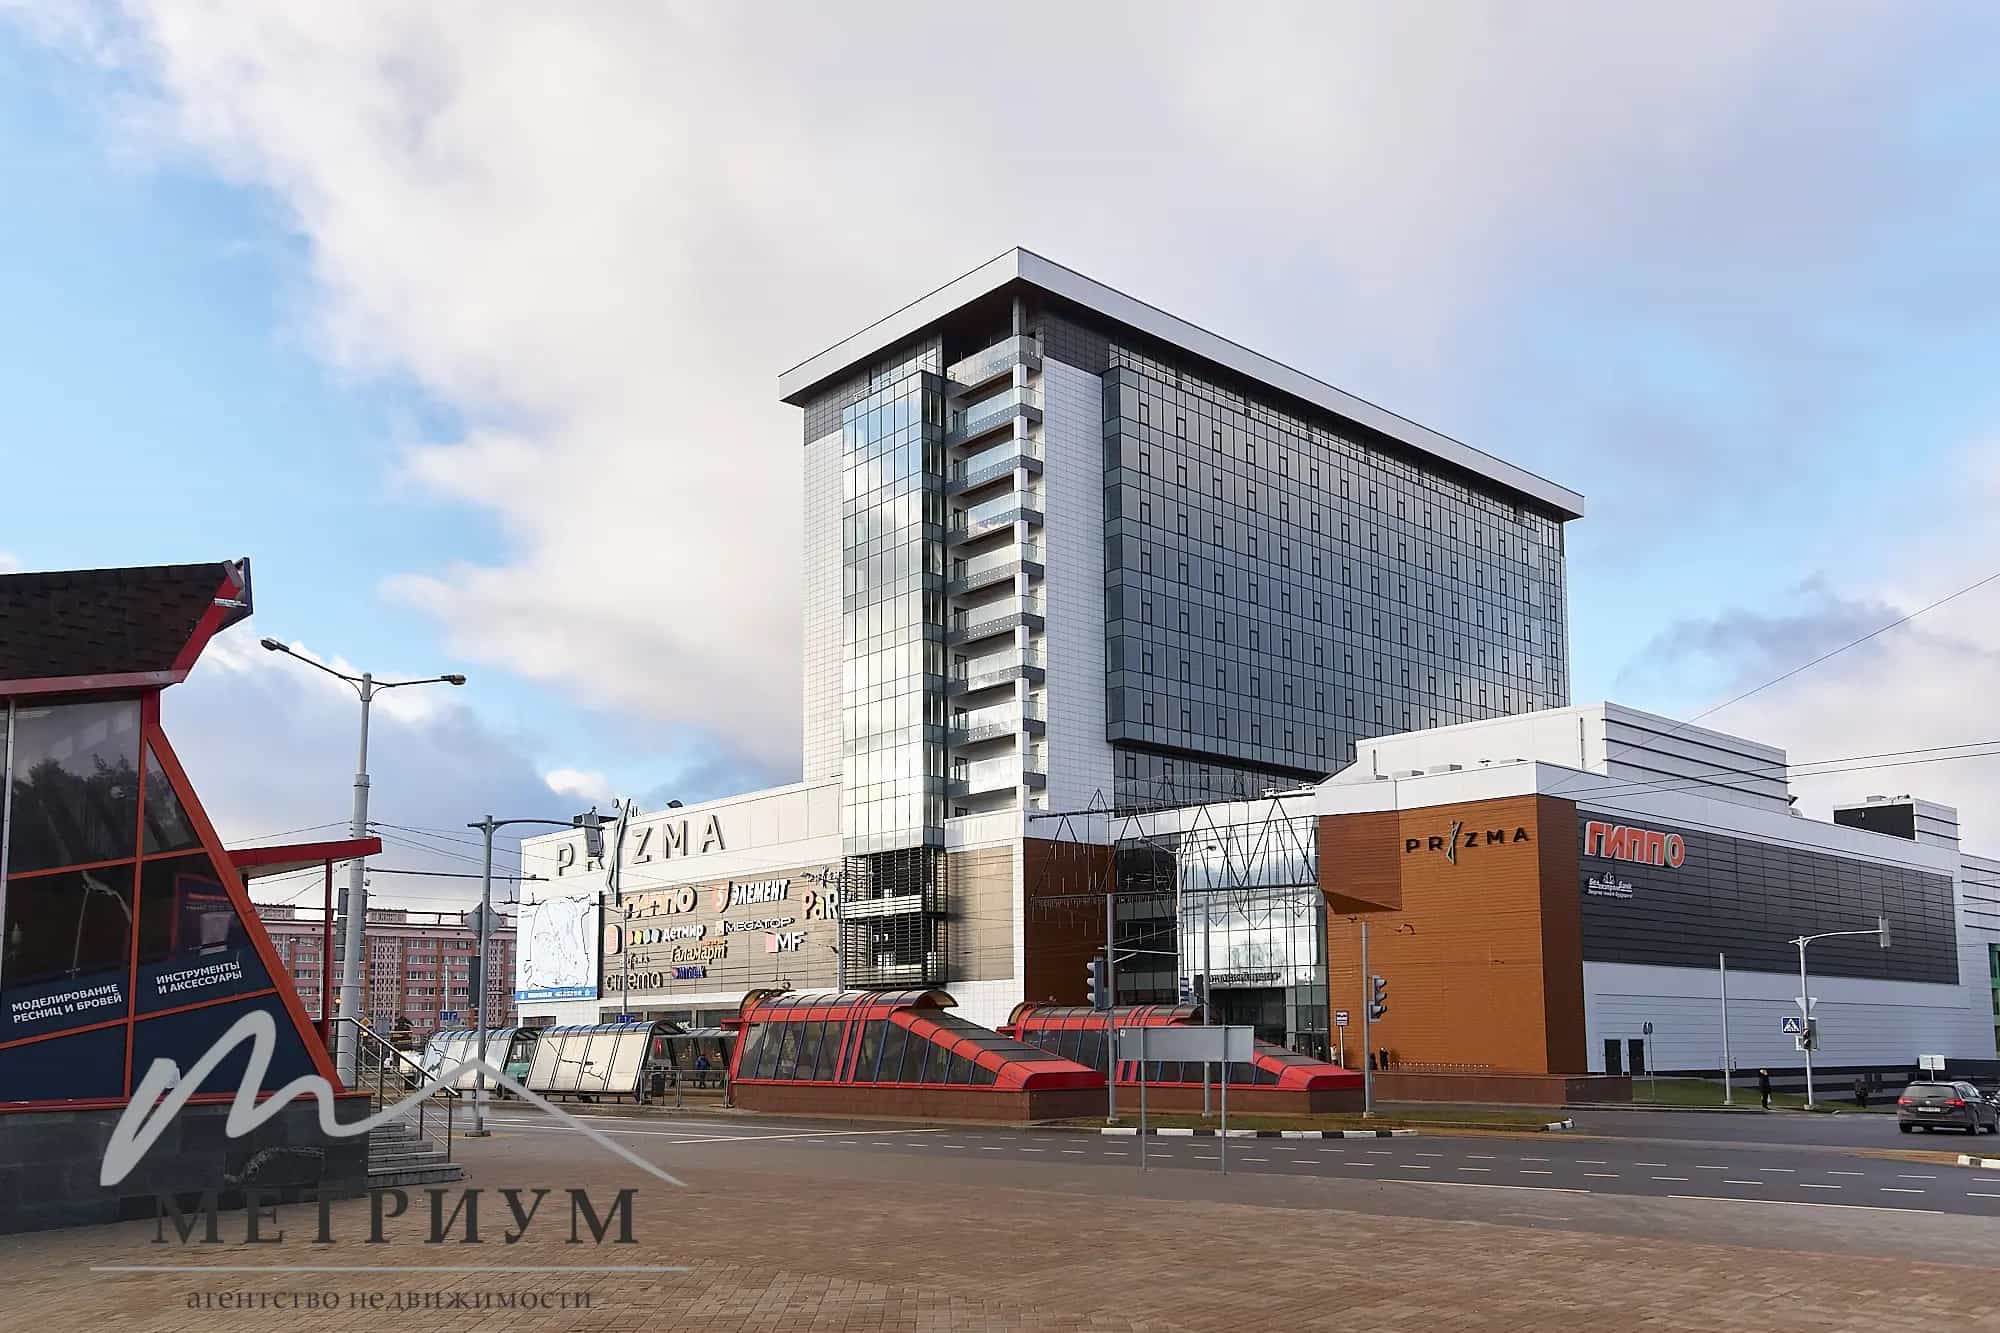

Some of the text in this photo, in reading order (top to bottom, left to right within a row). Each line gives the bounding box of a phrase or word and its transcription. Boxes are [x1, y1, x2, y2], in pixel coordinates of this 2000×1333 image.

[1405, 820, 1529, 865] PRIZMA
[1584, 821, 1685, 869] ГИППО
[731, 879, 790, 905] ЭЛЕМЕНТ
[725, 917, 796, 933] MEGATOP
[156, 960, 241, 985] ИНСТРУМЕНТЫ
[158, 970, 243, 995] И АКСЕССУАРЫ
[12, 983, 119, 1012] МОДЕЛИРОВАНИЕ
[13, 991, 123, 1024] РЕСНИЦ И БРОВЕЙ
